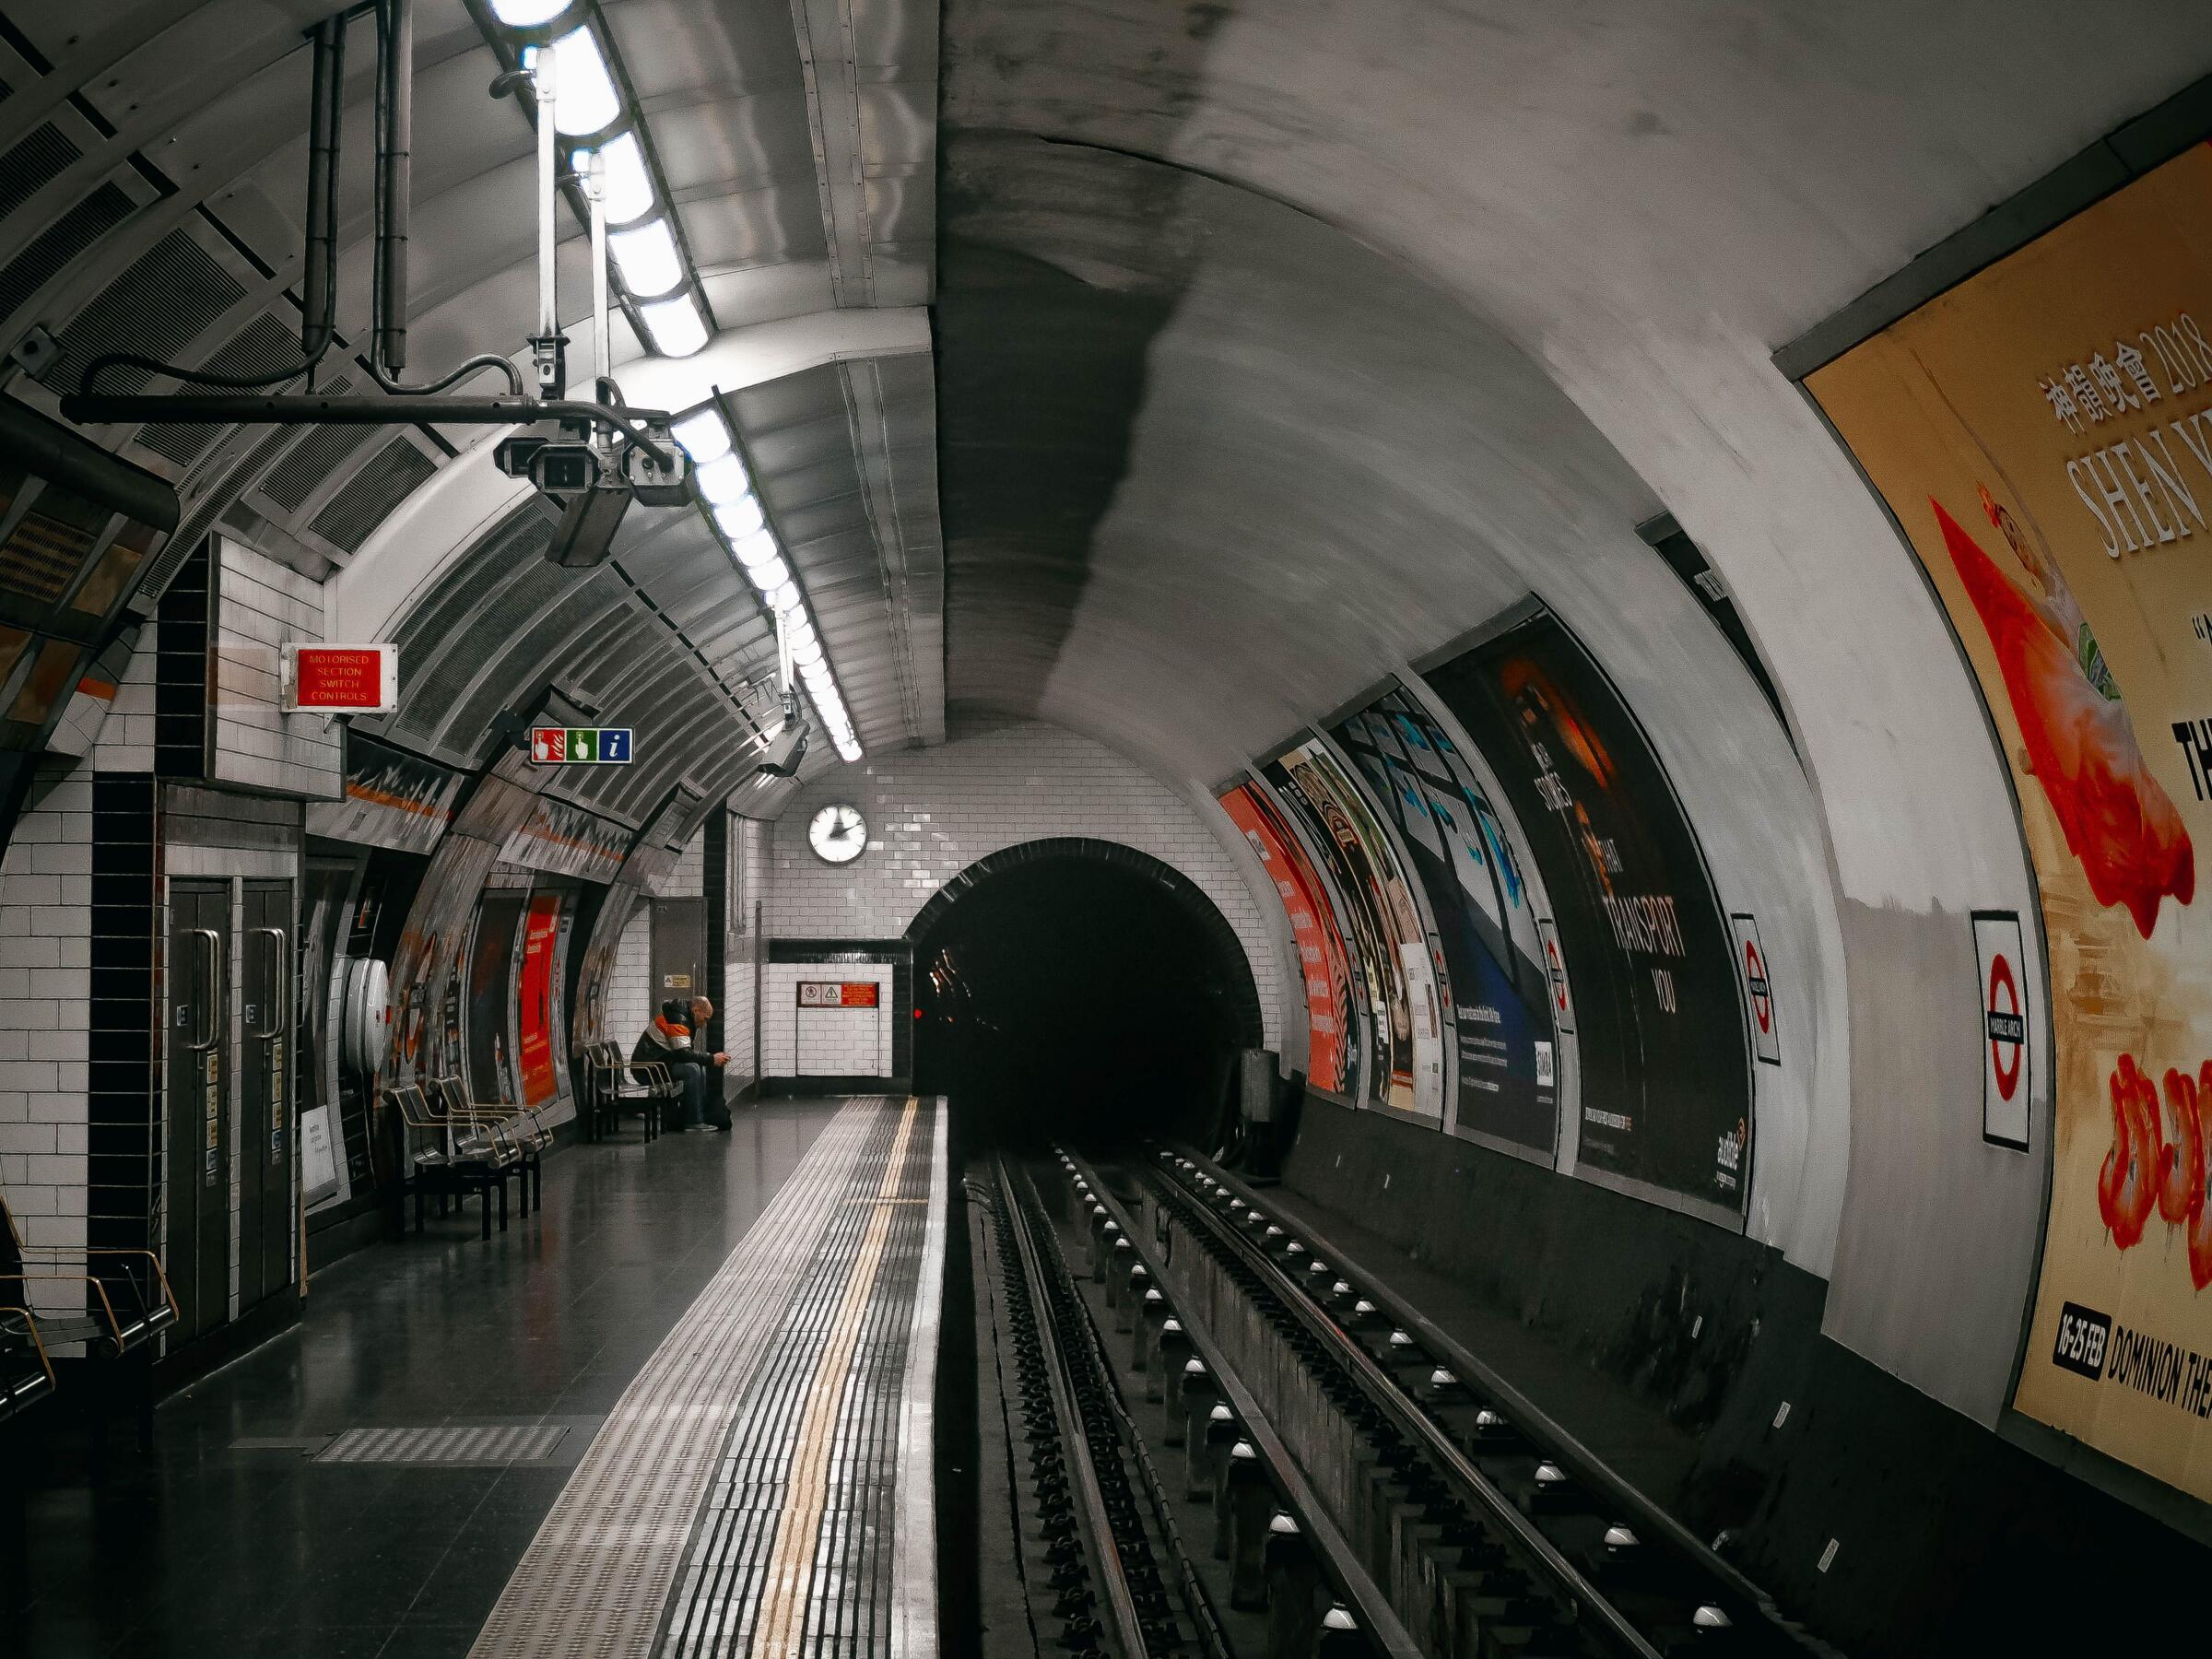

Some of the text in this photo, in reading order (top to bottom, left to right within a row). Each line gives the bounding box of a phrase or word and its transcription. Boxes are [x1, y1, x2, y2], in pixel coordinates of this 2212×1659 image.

[2066, 428, 2209, 559] SHEN
[309, 655, 369, 664] MOTORISED
[317, 667, 361, 676] SECTION
[311, 691, 367, 700] CONTROLS
[320, 680, 359, 688] SWITCH
[1602, 895, 1685, 958] TRANSPORT
[1651, 968, 1676, 1014] YOU
[1990, 1017, 2020, 1038] MARBLE ARCH
[2057, 1313, 2106, 1368] 16-25 FEB
[2107, 1324, 2212, 1419] DOMINION THE
